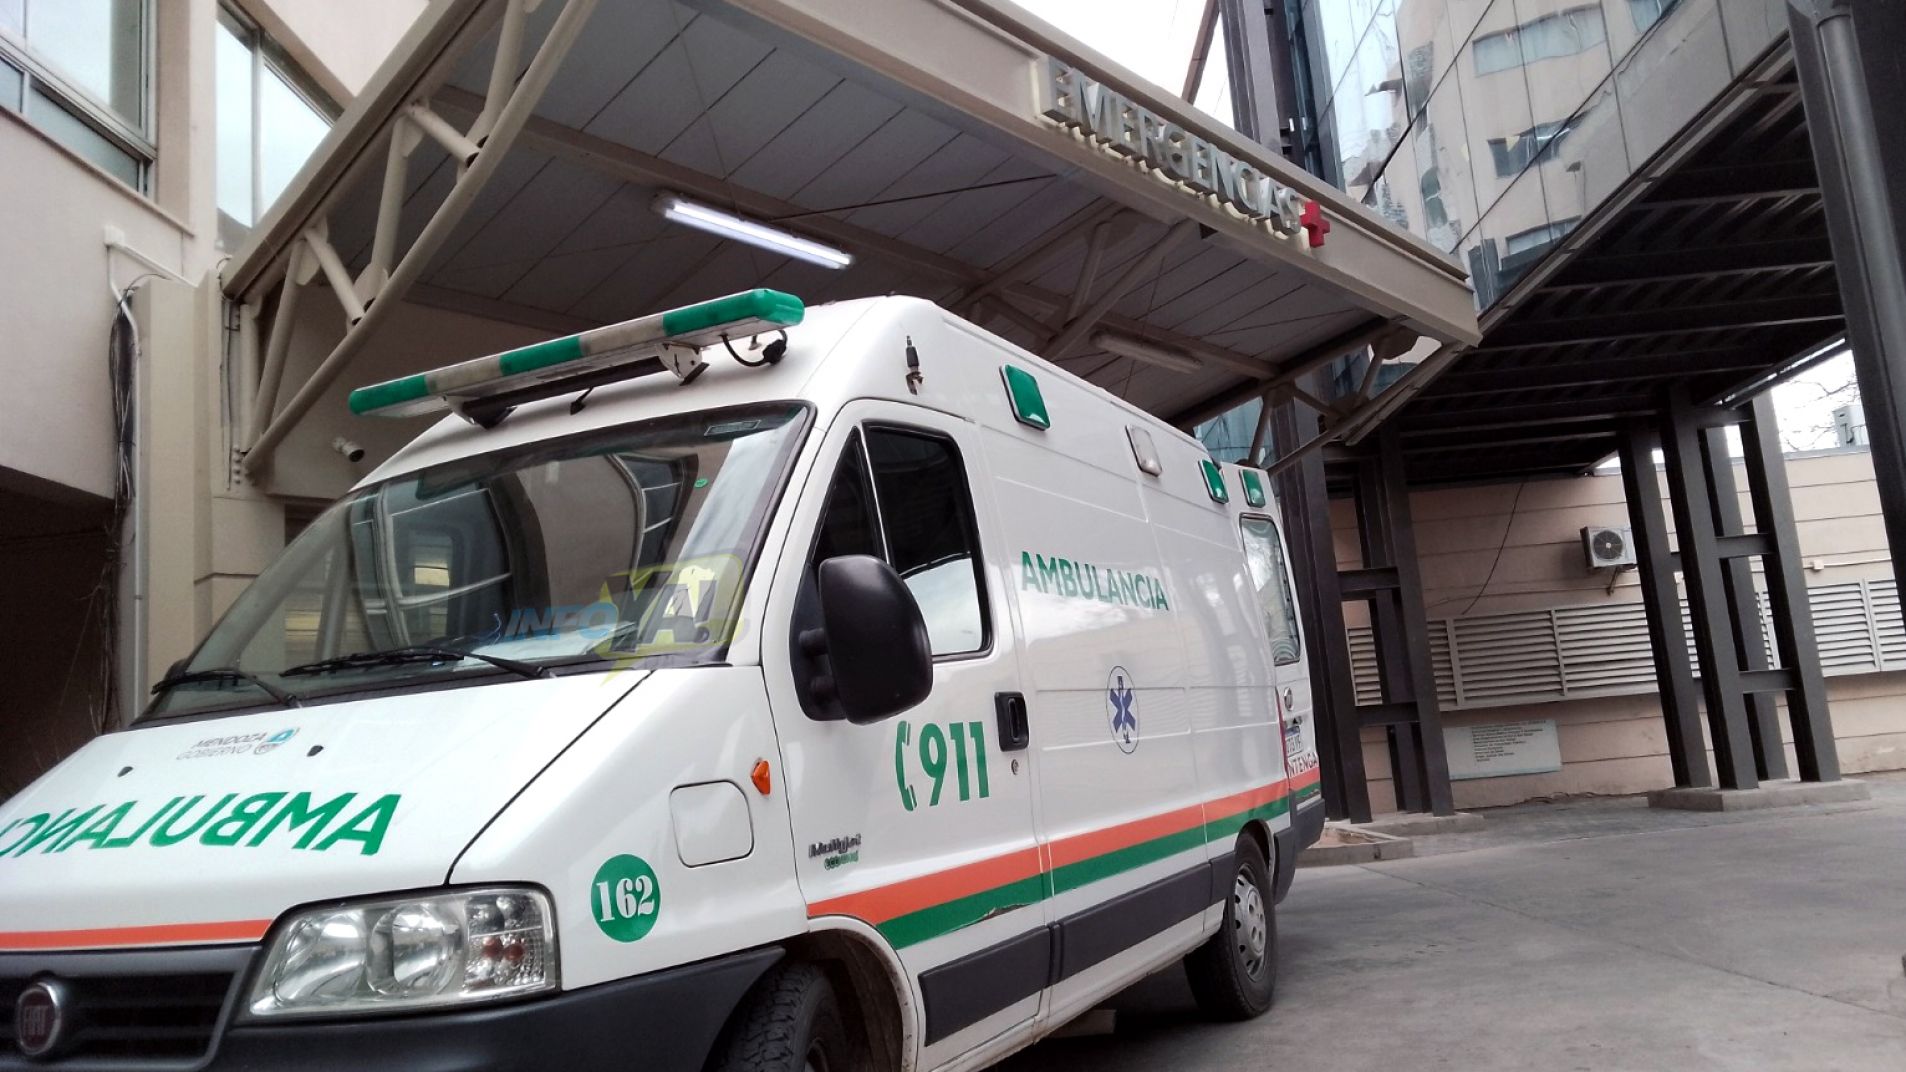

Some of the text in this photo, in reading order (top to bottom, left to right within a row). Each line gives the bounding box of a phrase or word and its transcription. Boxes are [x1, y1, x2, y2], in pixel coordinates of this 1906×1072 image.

[1041, 55, 1302, 235] EMERGENCIAS
[1021, 550, 1170, 611] AMBULANCIA
[190, 731, 268, 749] MENDOZA
[918, 720, 990, 807] 911
[595, 874, 655, 923] 162
[23, 1005, 49, 1036] FIAT
